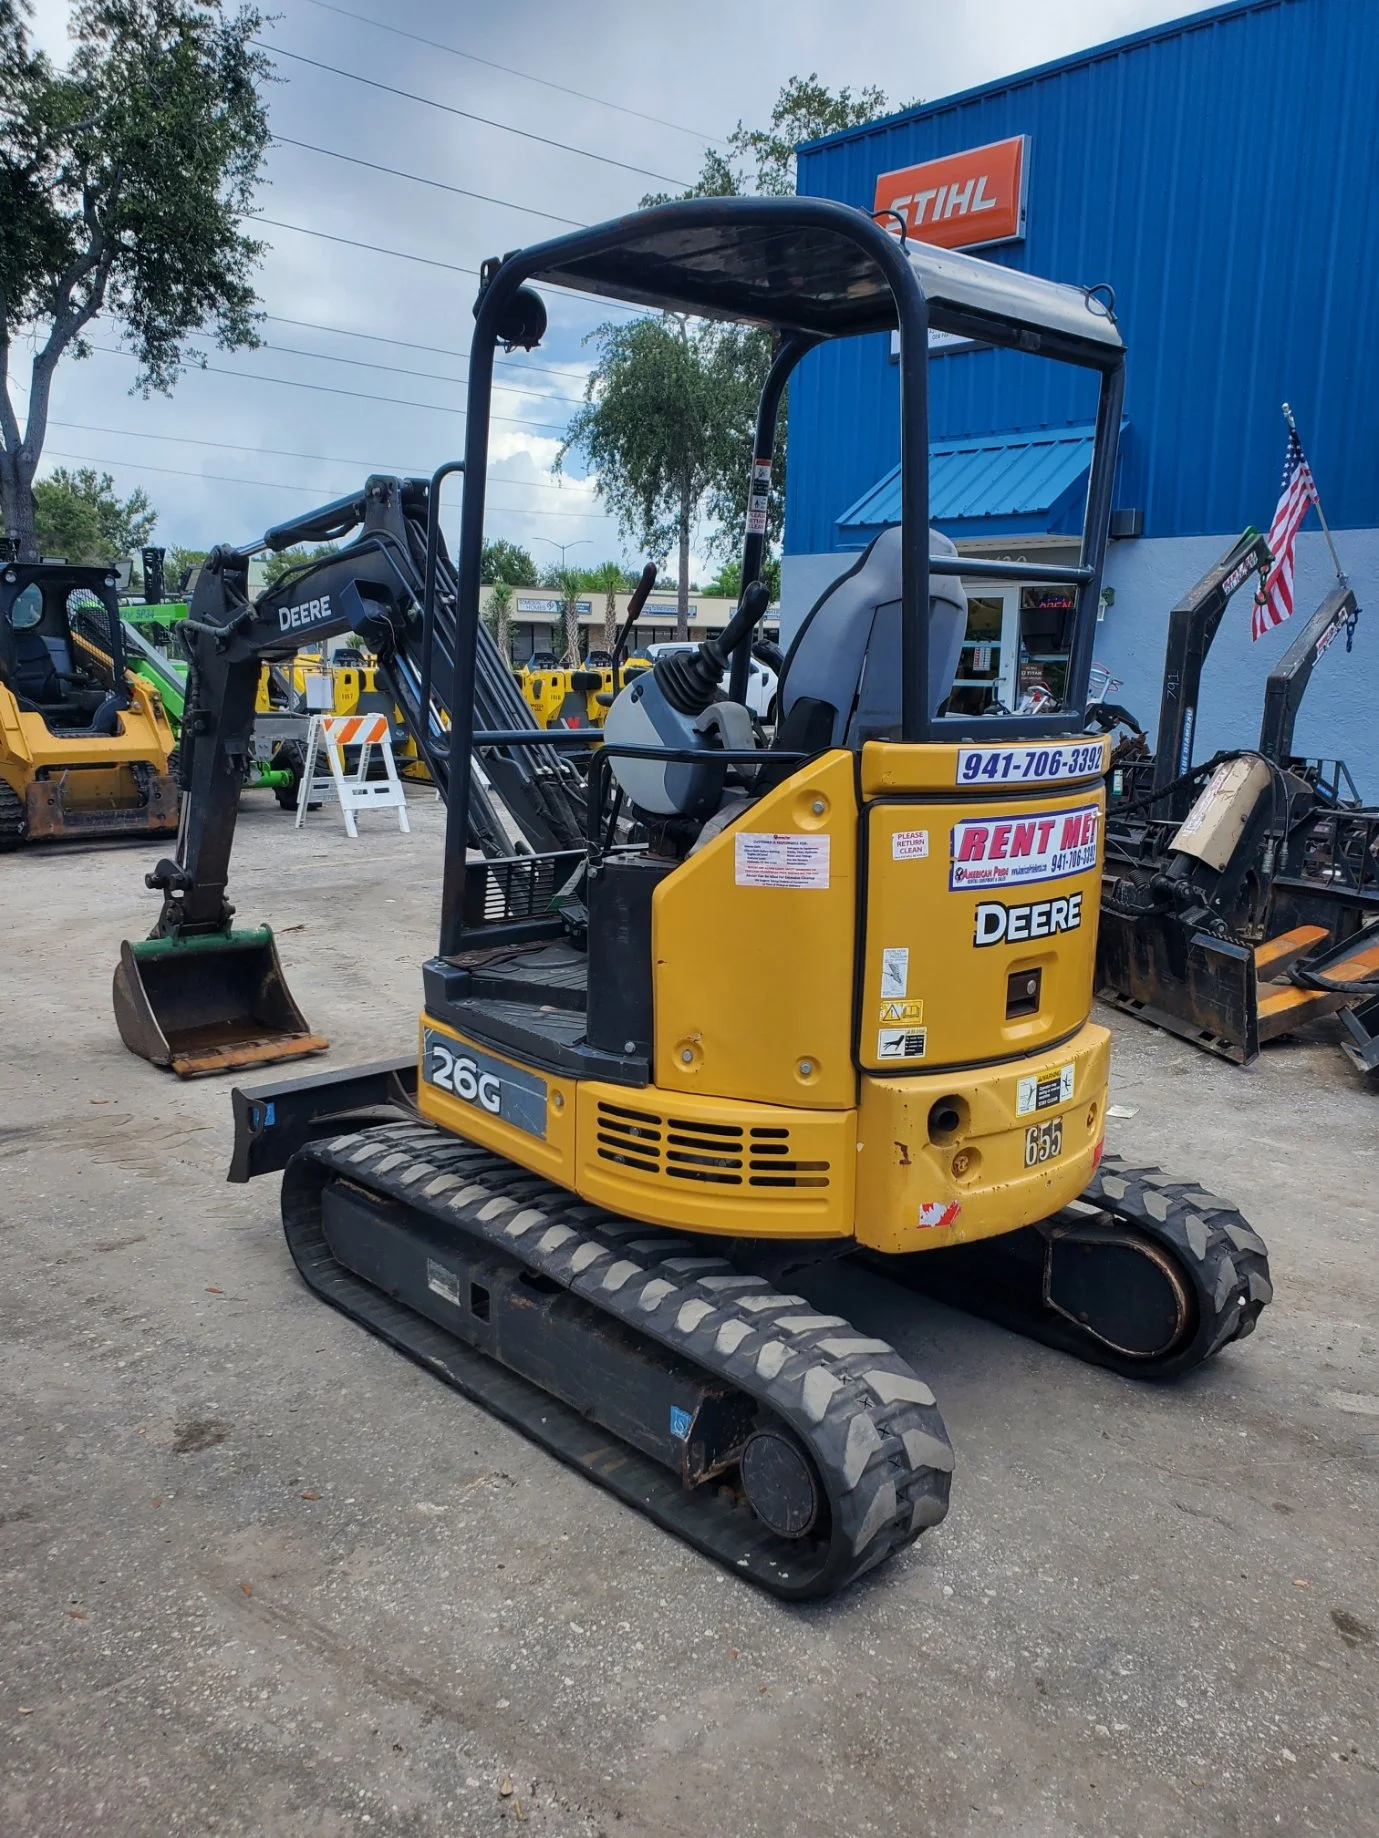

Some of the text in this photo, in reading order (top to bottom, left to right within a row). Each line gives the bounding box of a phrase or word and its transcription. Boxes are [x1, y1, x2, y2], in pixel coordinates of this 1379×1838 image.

[886, 175, 997, 232] STIHL
[278, 595, 332, 631] DEERE
[1167, 669, 1180, 699] 791
[961, 744, 1104, 780] 941-706-3392
[896, 839, 925, 847] RETURN
[897, 831, 924, 840] PLEASE
[957, 820, 1056, 862] RENT
[974, 893, 1083, 946] DEERE
[432, 1046, 501, 1114] 26G
[1025, 1116, 1062, 1167] 655
